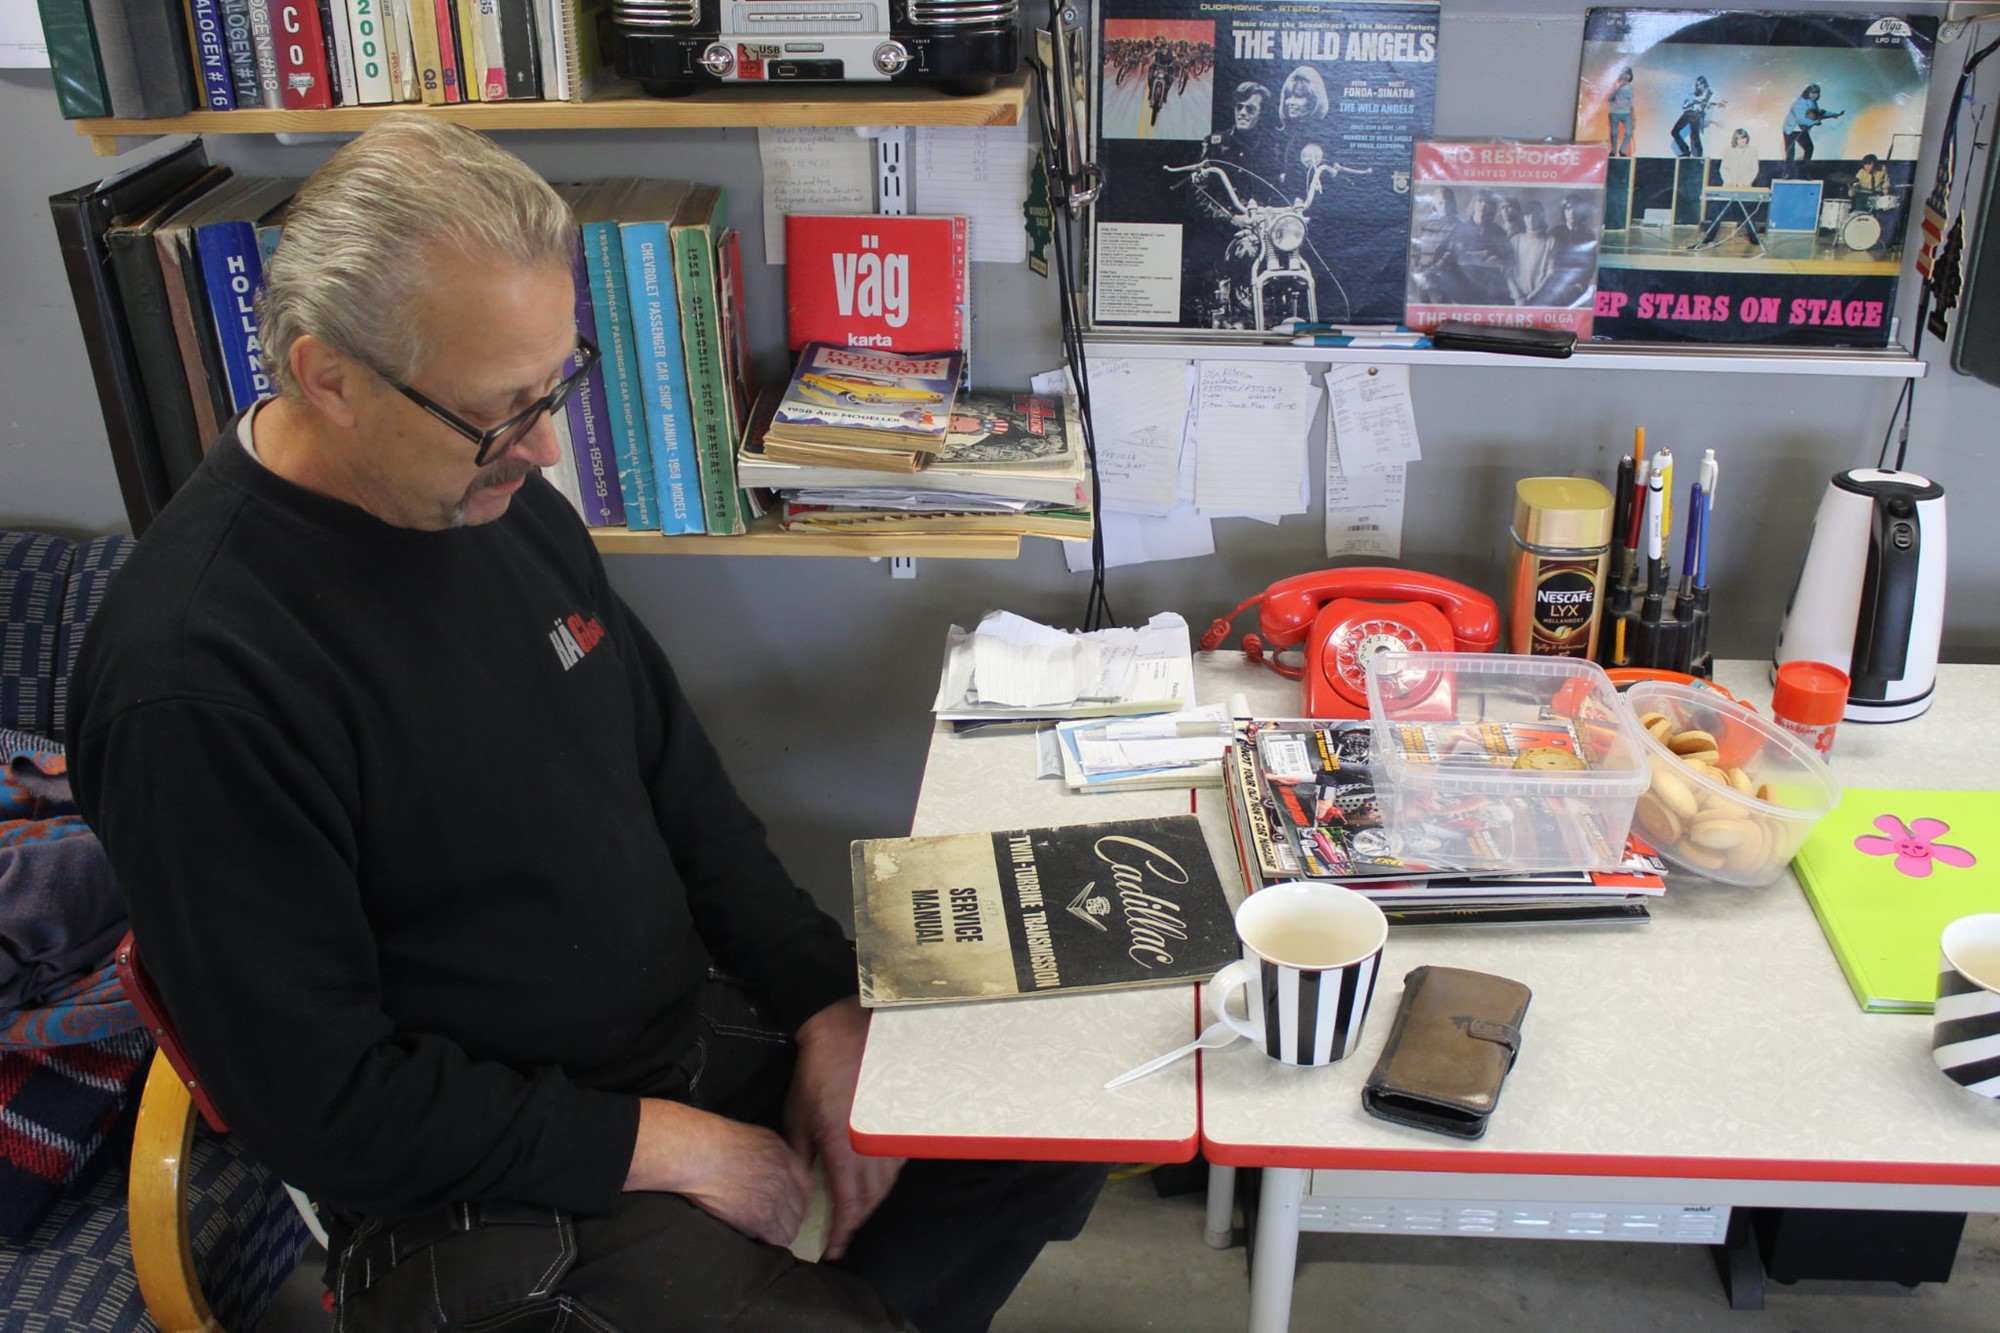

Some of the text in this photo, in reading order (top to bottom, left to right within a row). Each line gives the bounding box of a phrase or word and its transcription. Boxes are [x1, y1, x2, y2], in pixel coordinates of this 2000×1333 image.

[1200, 4, 1320, 13] DUOPHONIC STEREO
[1232, 20, 1257, 28] Music
[1259, 20, 1280, 28] from
[1282, 21, 1296, 29] the
[1299, 21, 1346, 30] Soundtrack
[1348, 22, 1358, 30] of
[1405, 23, 1437, 31] Picture
[1880, 20, 1902, 31] Olga
[357, 0, 379, 79] 2000
[759, 45, 781, 55] USB
[1232, 29, 1436, 63] THE WILD ANGELS
[423, 68, 438, 91] Q8
[444, 67, 456, 87] Q8
[211, 87, 228, 107] 16
[1339, 103, 1415, 114] THE WILD ANGELS
[1443, 147, 1581, 167] NO RESPONSE
[1463, 168, 1558, 179] RENTED TUXEDO
[640, 242, 660, 297] CHEVROLET
[832, 234, 909, 328] väg
[604, 269, 619, 323] CHEVROLET
[1487, 313, 1534, 328] STARS
[1544, 313, 1573, 324] OLGA
[1594, 291, 1885, 328] EP STARS ON STAGE
[227, 255, 275, 400] HOLLAND
[648, 301, 666, 358] PASSENGER
[848, 333, 893, 347] karta
[612, 325, 628, 378] PASSENGER
[655, 361, 670, 381] CAR
[620, 379, 631, 400] CAR
[688, 248, 727, 518] 1958 OLDSMOBILE SHOP MANUAL 1958
[658, 385, 673, 416] SHOP
[624, 401, 635, 426] SHOP
[787, 406, 813, 415] 1958
[841, 412, 901, 422] MODELLER
[660, 414, 679, 453] MANUAL
[627, 430, 641, 466] MANUAL
[591, 447, 608, 497] 1950-59
[671, 483, 687, 520] MODELS
[1537, 586, 1594, 604] NESCAFÉ
[1551, 604, 1580, 617] LYX
[1243, 767, 1256, 789] YOUR
[1246, 787, 1259, 800] OLD
[1250, 800, 1264, 821] MAN'S
[1254, 821, 1268, 837] CAR
[1008, 834, 1061, 987] TWIN-TURBINE TRANSMISSION
[1093, 834, 1189, 969] Cadillac
[911, 889, 945, 945] MANUAL
[949, 887, 984, 943] SERVICE
